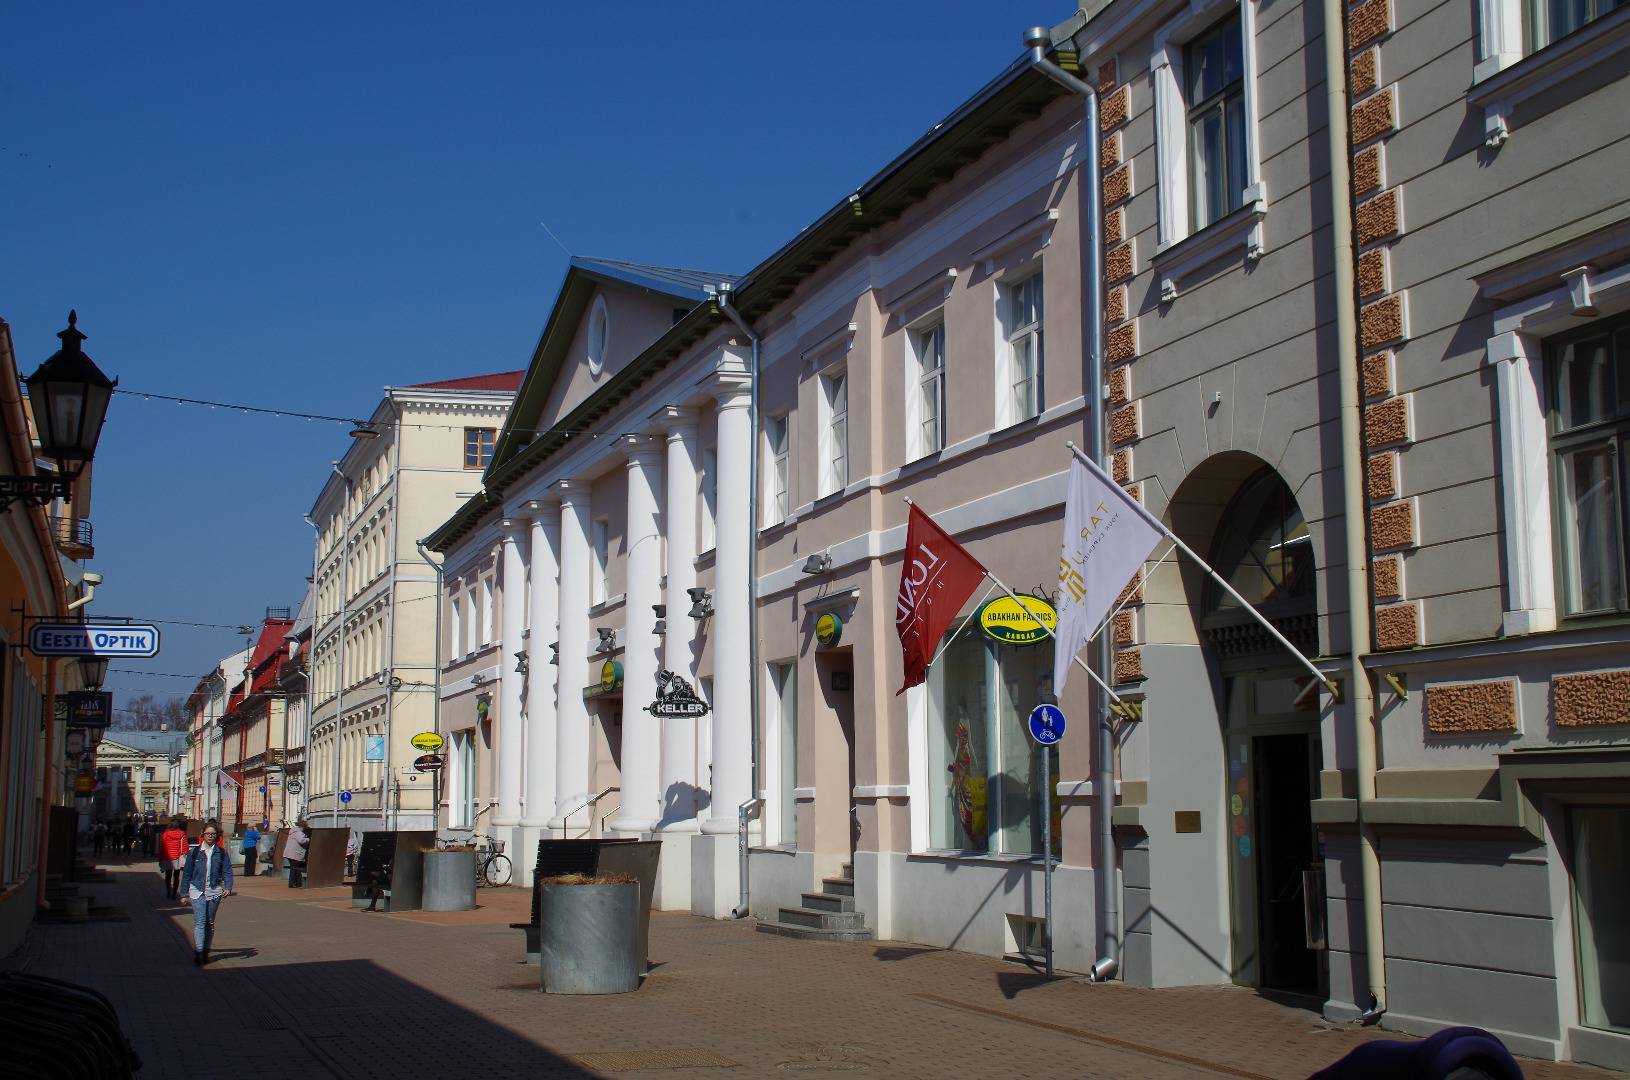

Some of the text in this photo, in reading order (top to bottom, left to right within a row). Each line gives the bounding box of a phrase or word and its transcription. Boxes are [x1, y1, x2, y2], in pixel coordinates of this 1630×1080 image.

[987, 613, 1052, 621] ABAKHAN FARICS
[41, 632, 146, 648] EESTI OPTIK
[657, 704, 704, 713] KELLER
